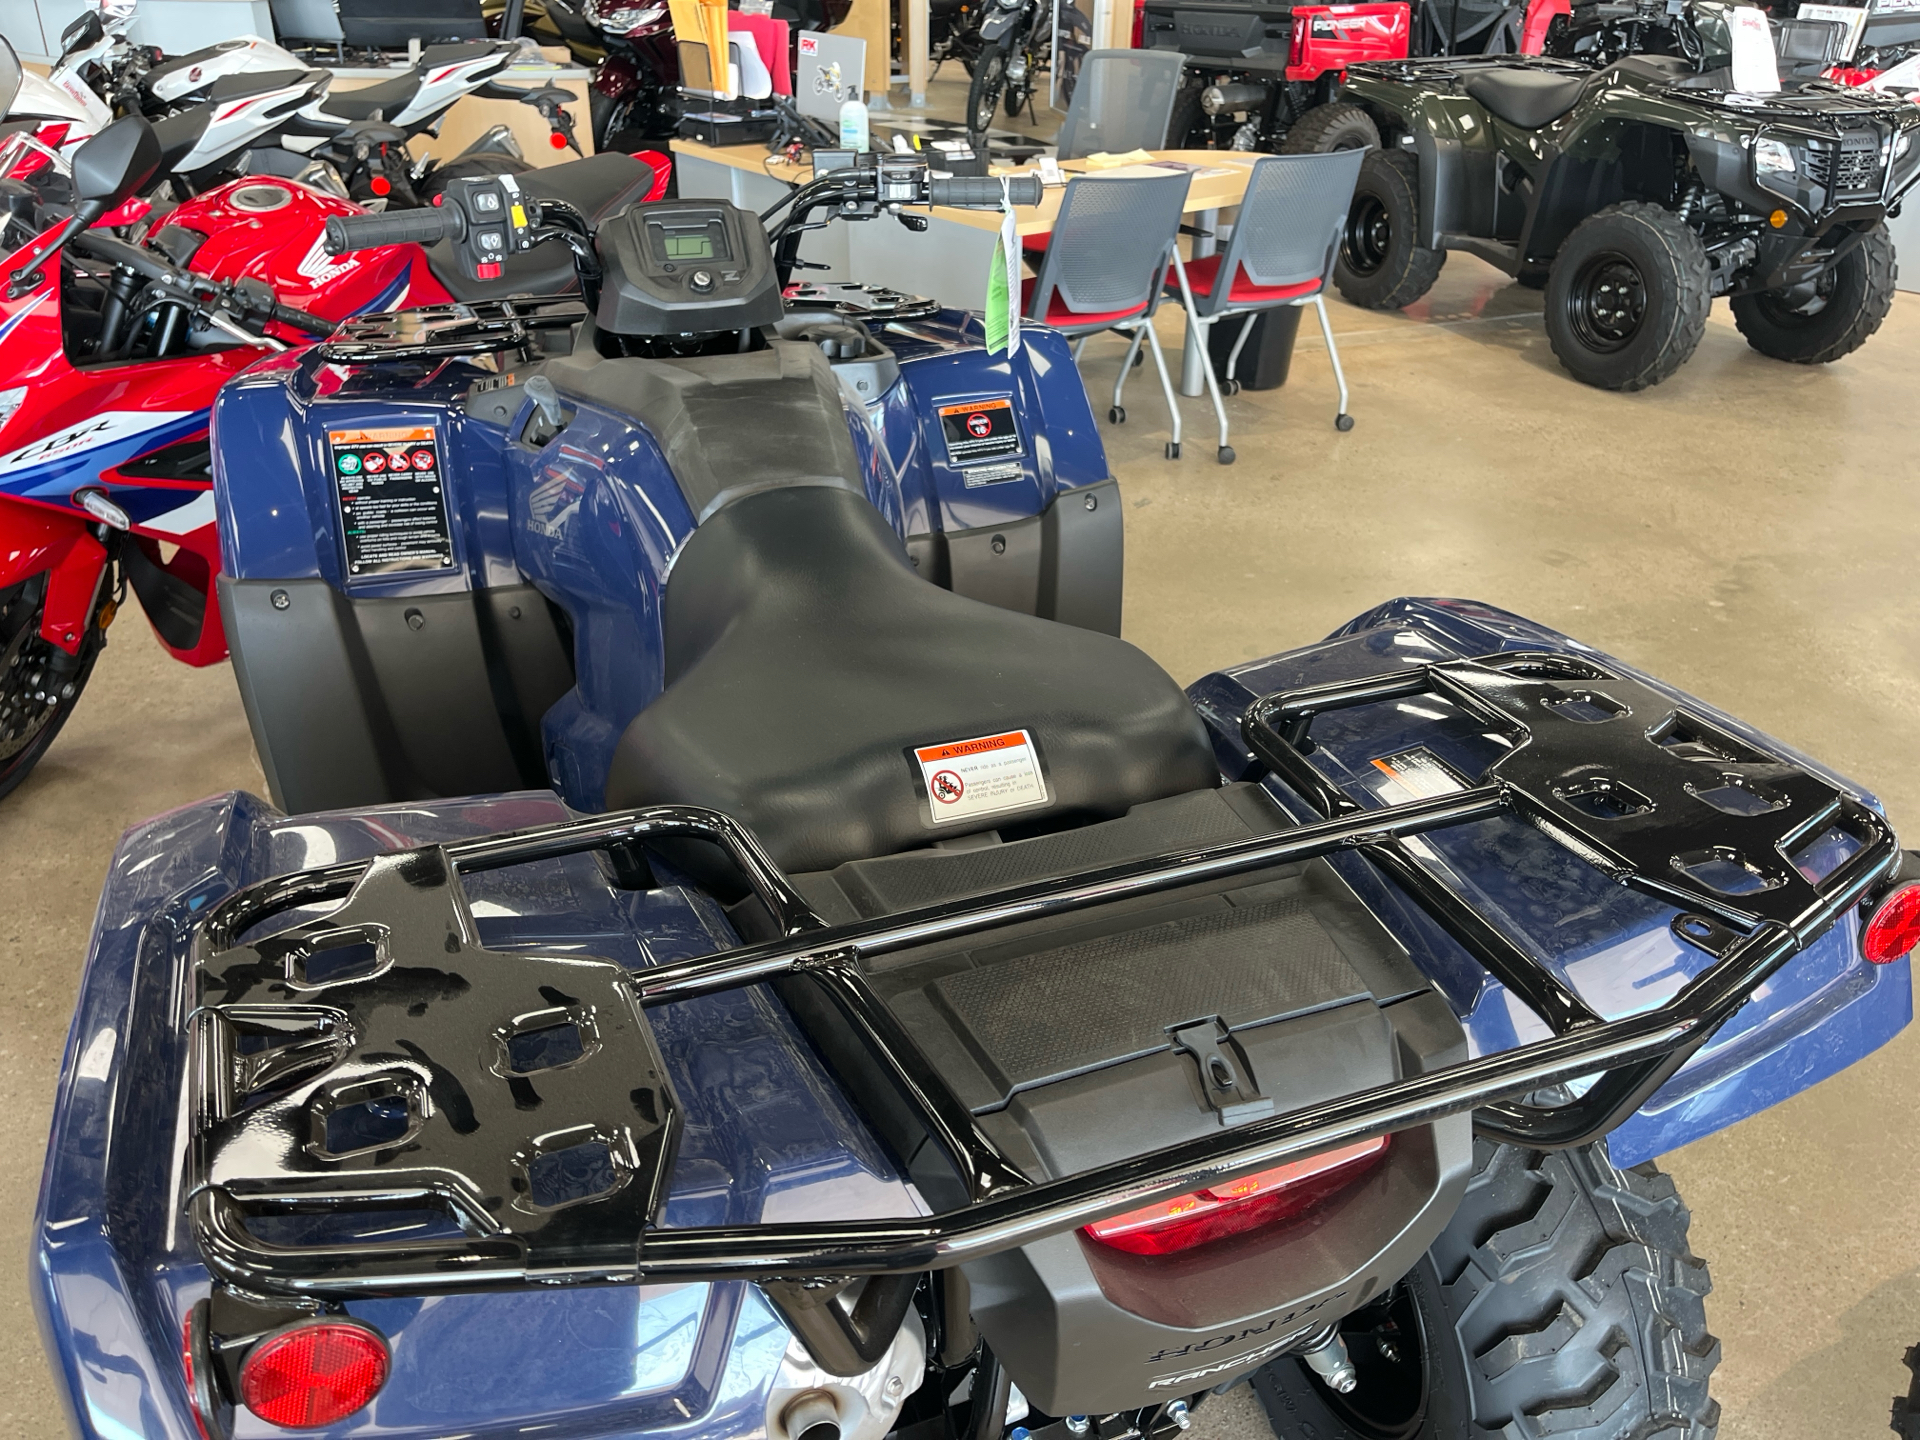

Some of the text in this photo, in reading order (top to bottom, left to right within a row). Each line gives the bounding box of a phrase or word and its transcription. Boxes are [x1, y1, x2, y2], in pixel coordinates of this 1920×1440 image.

[1313, 17, 1366, 31] PIONEER
[801, 40, 816, 51] RK
[308, 258, 361, 290] HONDA
[962, 403, 996, 412] WARNING
[975, 426, 986, 434] 16
[526, 519, 563, 540] HONDA
[953, 739, 1005, 754] WARNING
[1144, 1291, 1348, 1364] HONDA
[1148, 1321, 1317, 1389] RANCHER
